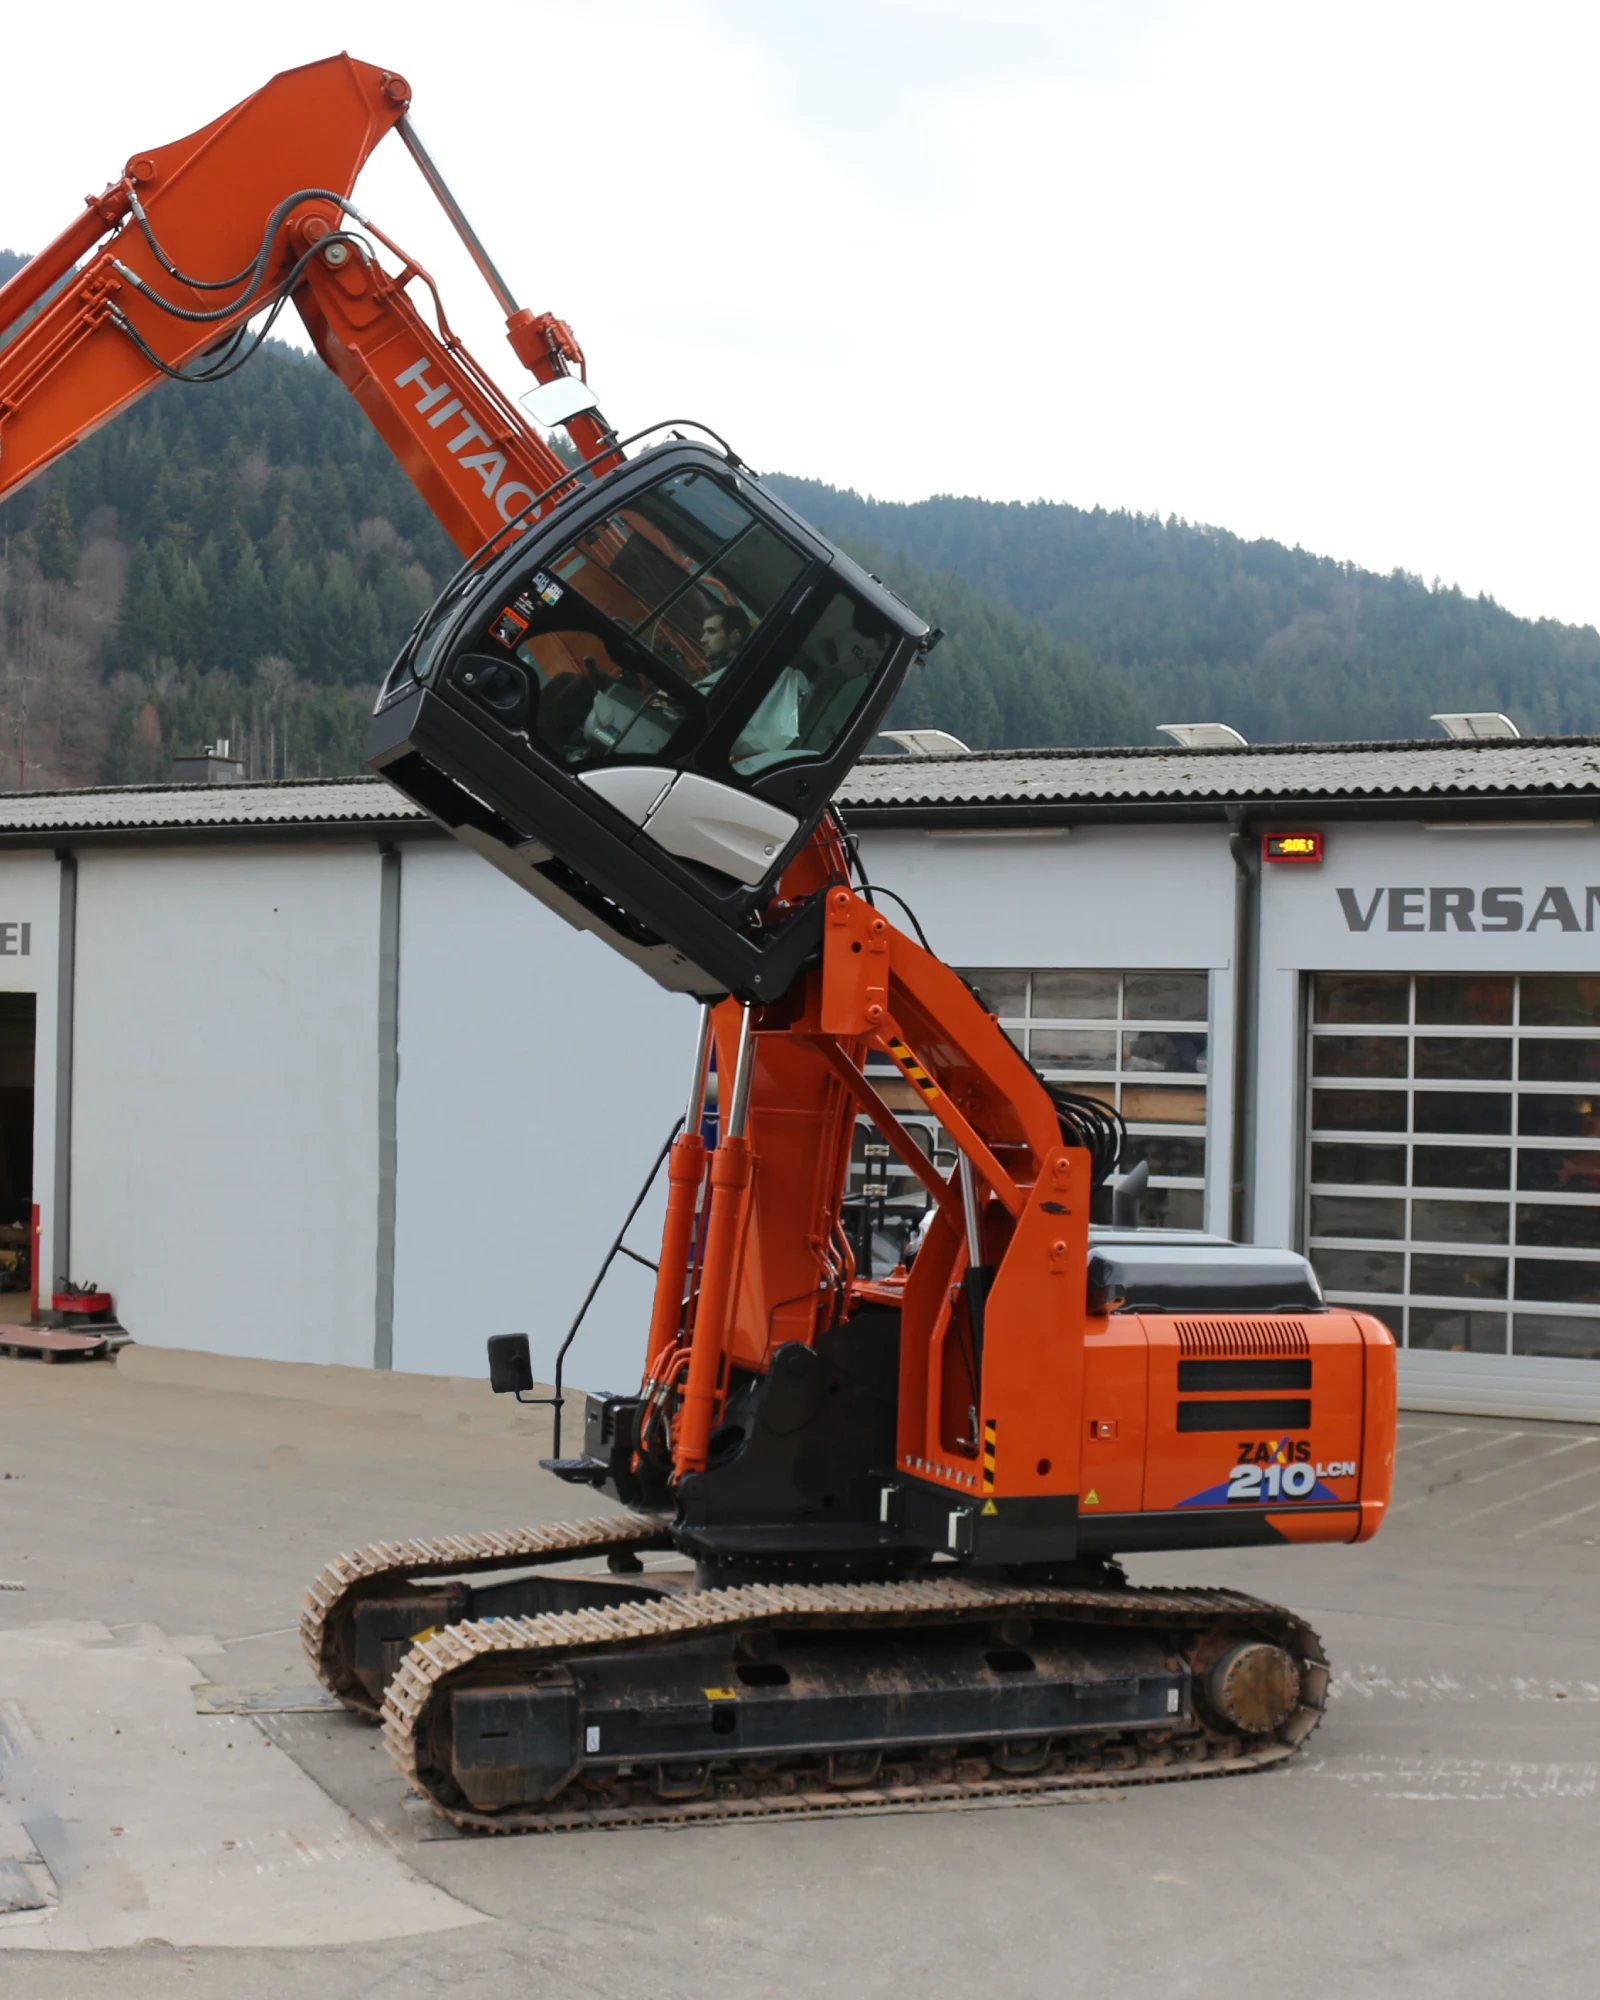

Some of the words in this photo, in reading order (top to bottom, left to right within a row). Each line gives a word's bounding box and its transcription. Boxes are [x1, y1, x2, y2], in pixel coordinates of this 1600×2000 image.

[1335, 886, 1600, 932] VERSA
[1237, 1436, 1312, 1464] ZAXIS
[1227, 1462, 1316, 1500] 210
[1316, 1461, 1357, 1479] LCN
